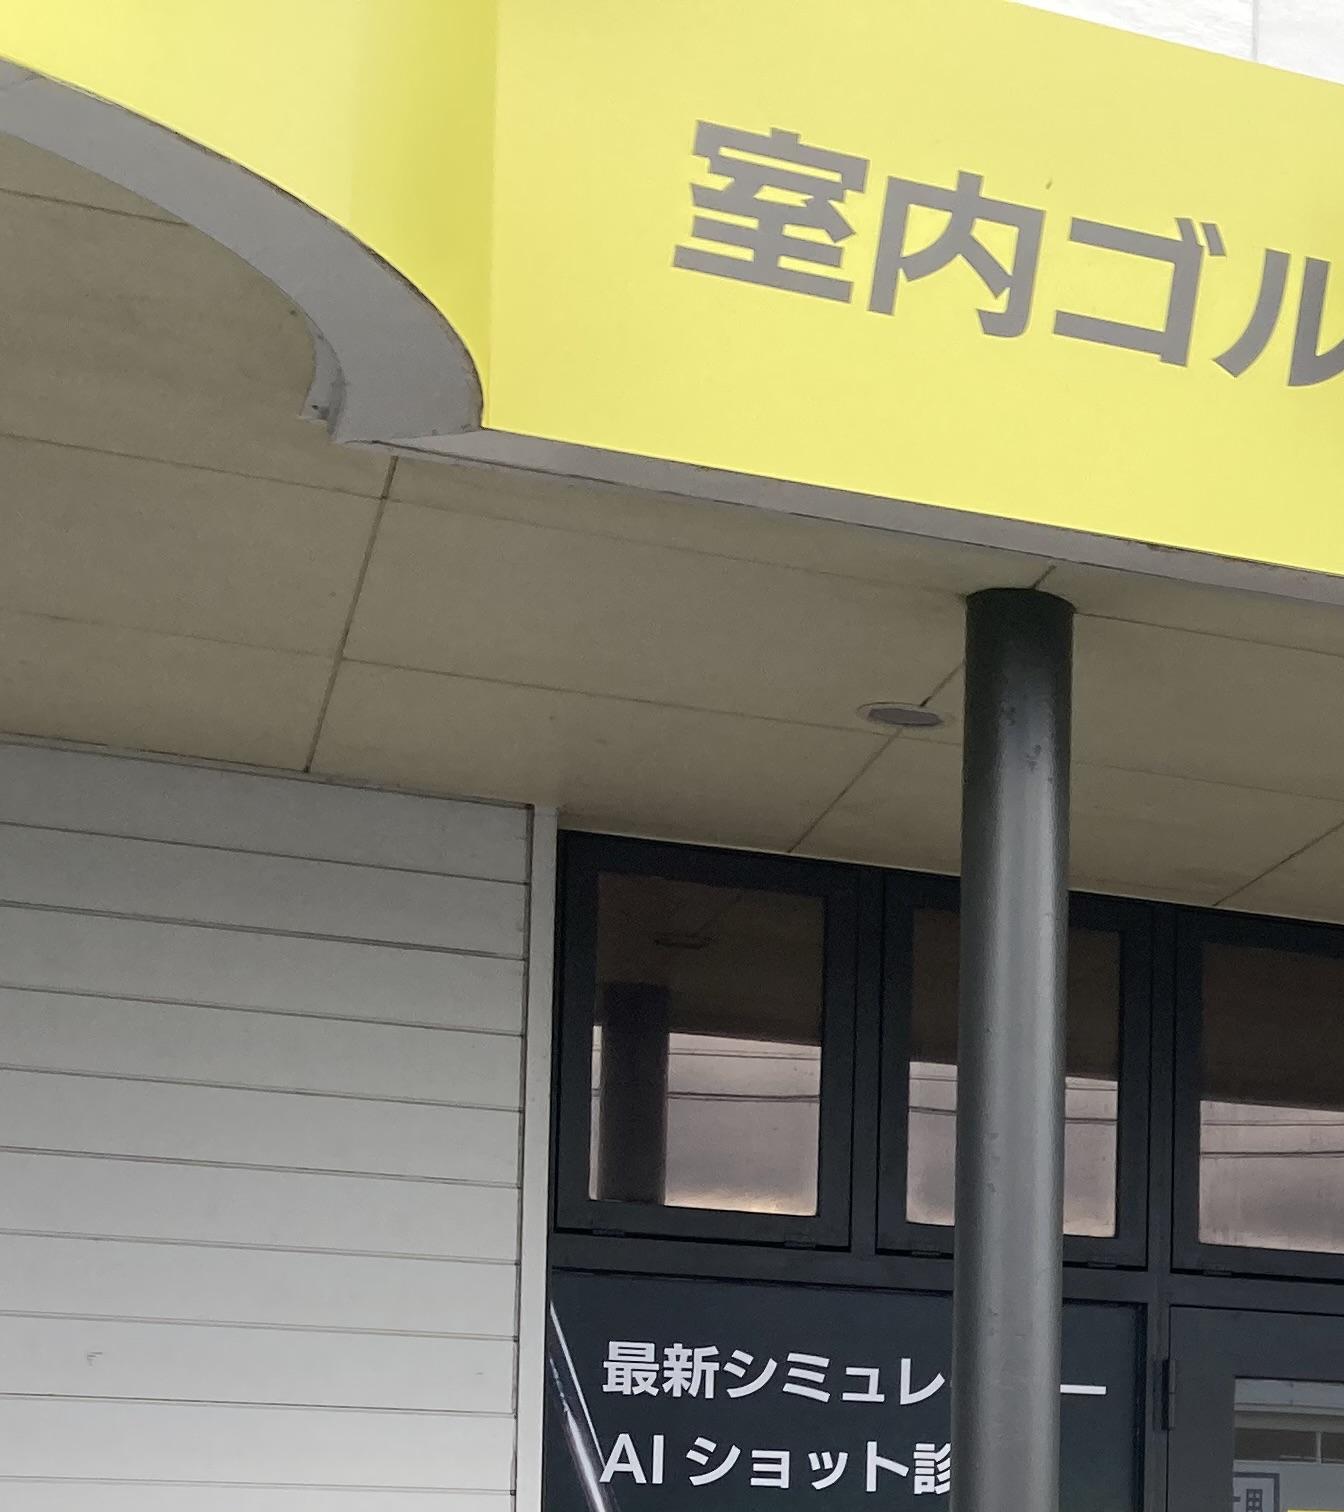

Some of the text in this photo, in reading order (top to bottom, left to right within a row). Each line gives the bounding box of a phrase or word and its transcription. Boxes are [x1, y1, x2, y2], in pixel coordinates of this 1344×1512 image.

[602, 1340, 1107, 1405] 最新シミュレー
